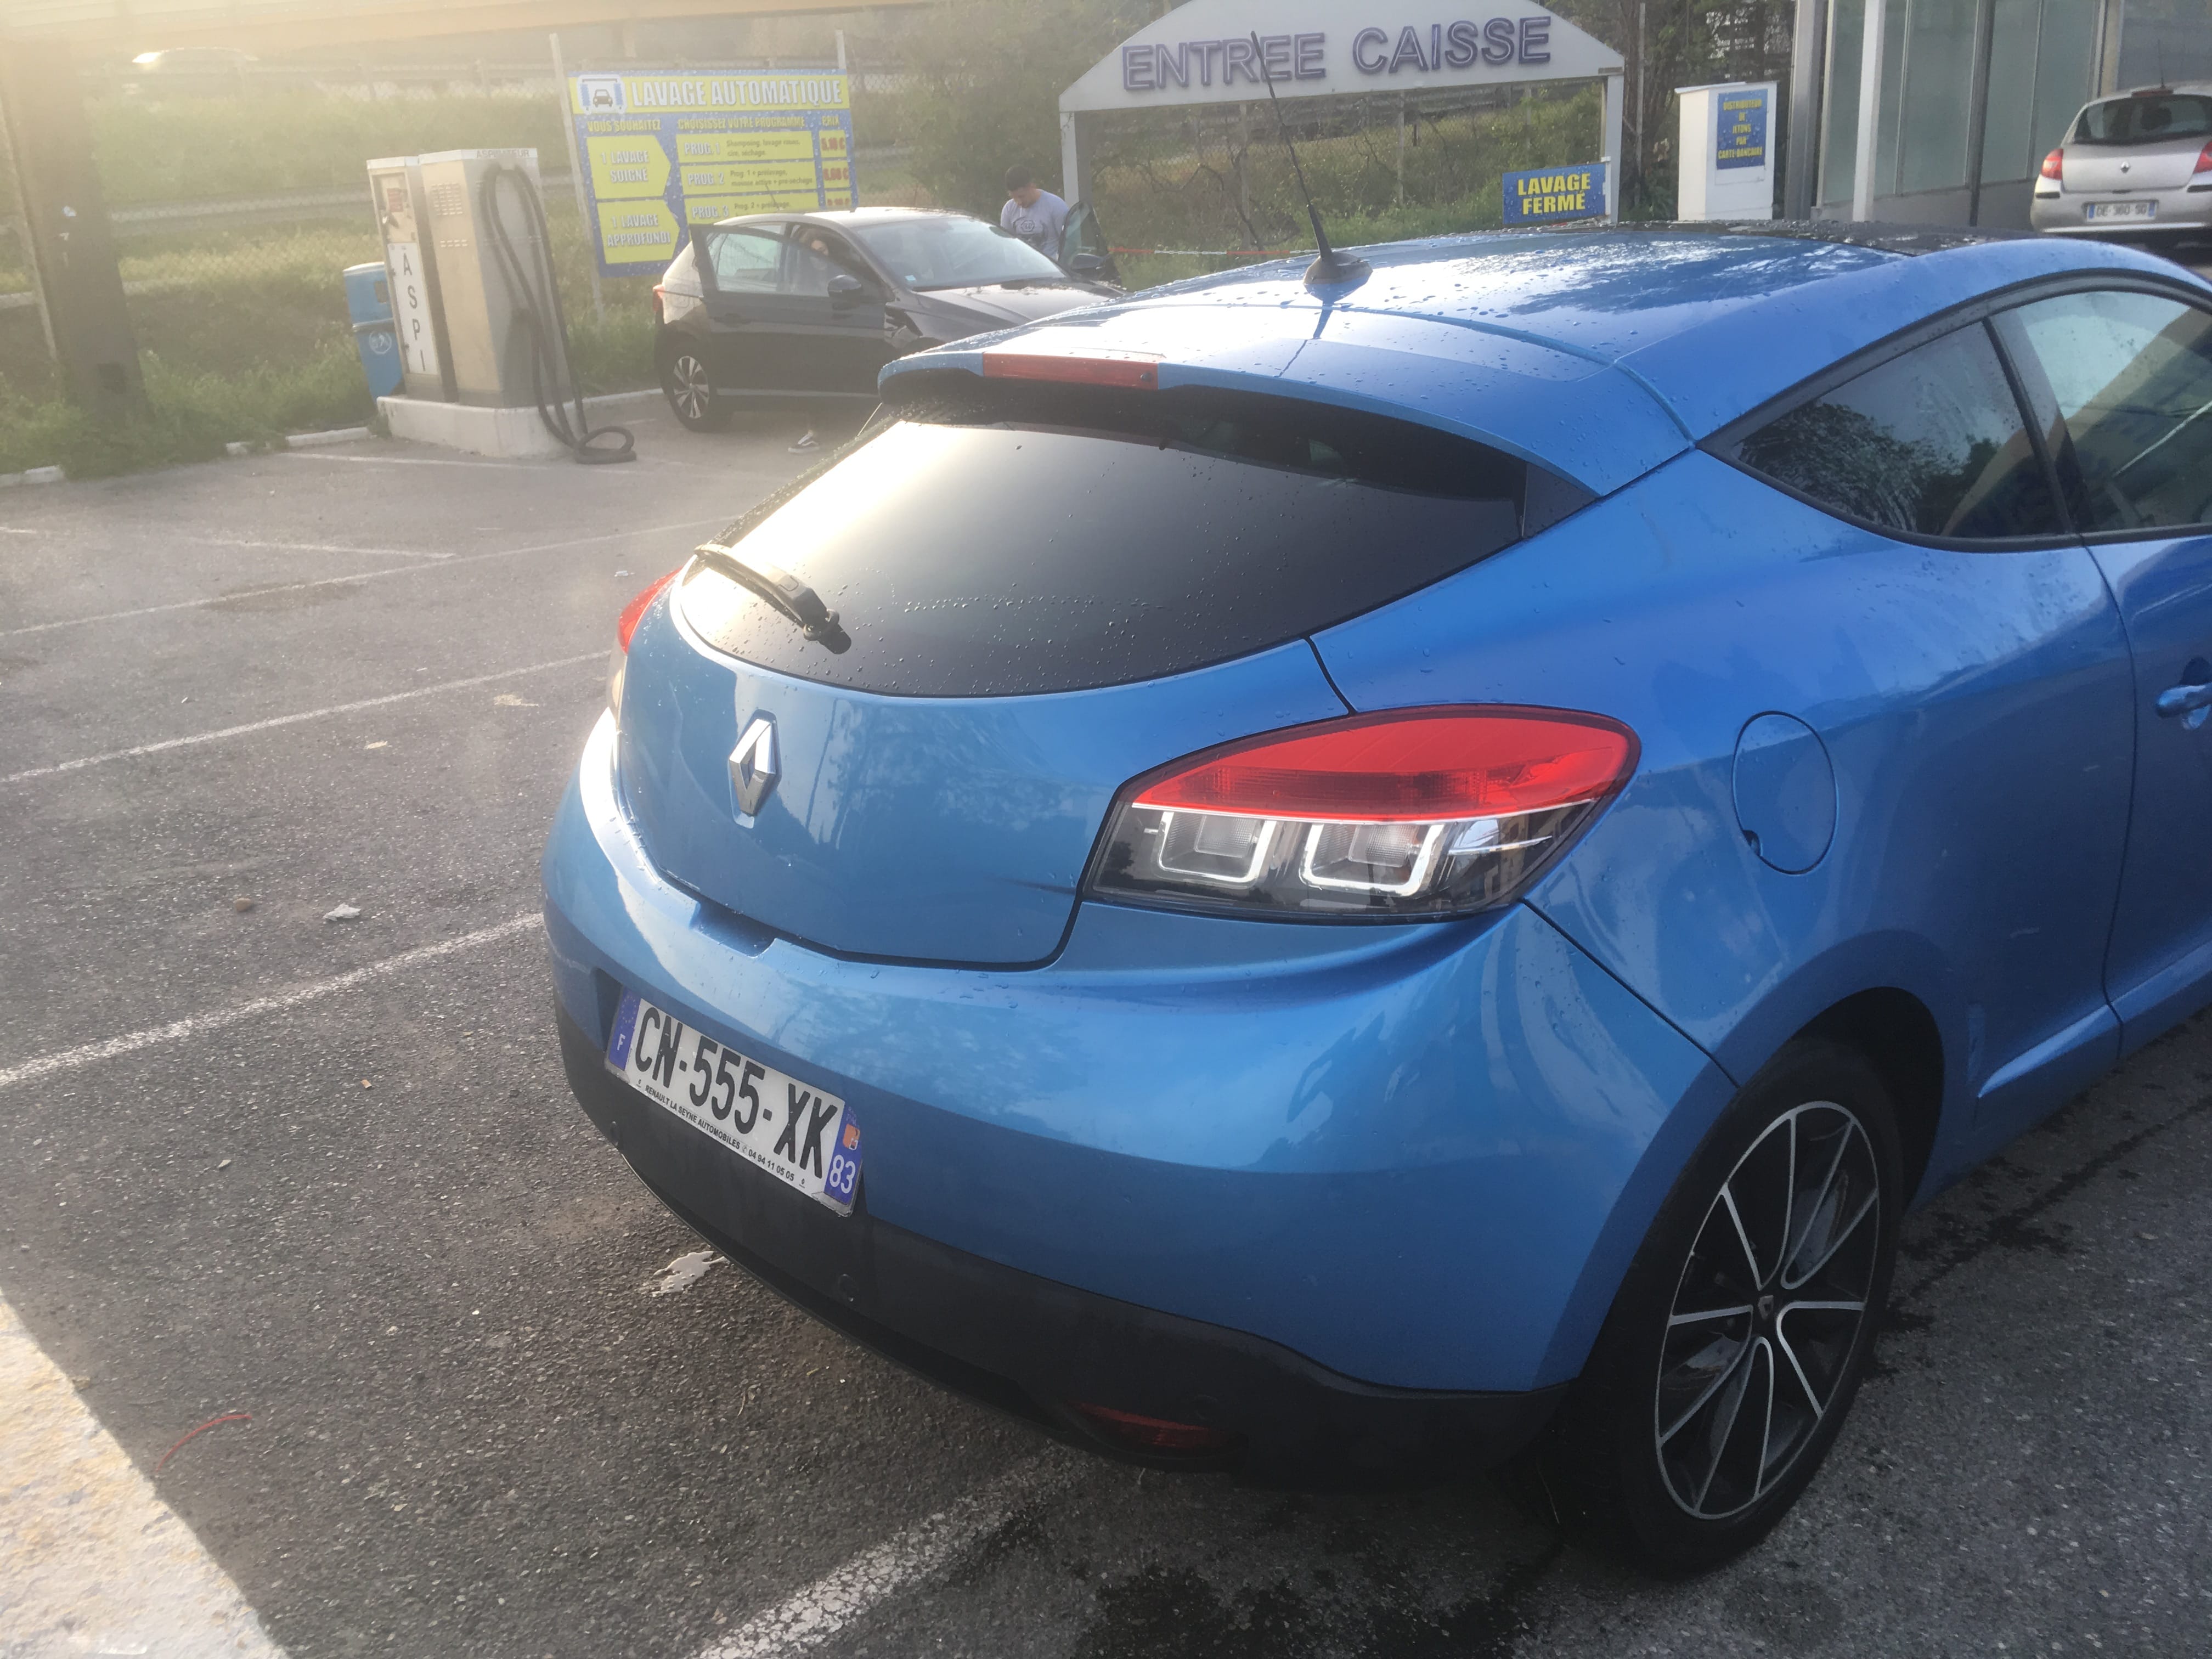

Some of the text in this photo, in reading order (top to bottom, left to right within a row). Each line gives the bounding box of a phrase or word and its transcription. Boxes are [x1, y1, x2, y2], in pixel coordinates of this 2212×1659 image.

[1122, 16, 1551, 91] ENTREE CAISSE
[631, 80, 843, 107] LAVAGE AUTOMATIQUE
[587, 119, 661, 132] VOUS SOUHAITEZ
[678, 116, 805, 130] CHOISISSEZ VOTRE PROGRAMME
[601, 150, 650, 164] 1 LAVAGE
[684, 143, 720, 155] PROG. 1
[688, 172, 725, 185] PROG. 2
[1517, 172, 1591, 196] LAVAGE
[723, 206, 729, 218] 3
[612, 213, 659, 229] 1 LAVAGE
[607, 231, 671, 247] APPROFONDI
[403, 252, 426, 372] ASPI
[616, 1032, 626, 1051] F
[635, 1007, 838, 1179] CN-555-XK
[645, 1085, 795, 1182] RENAULT LA SEYNE AUTOMOBILES 04 94 11 05 05
[829, 1154, 856, 1194] 83
